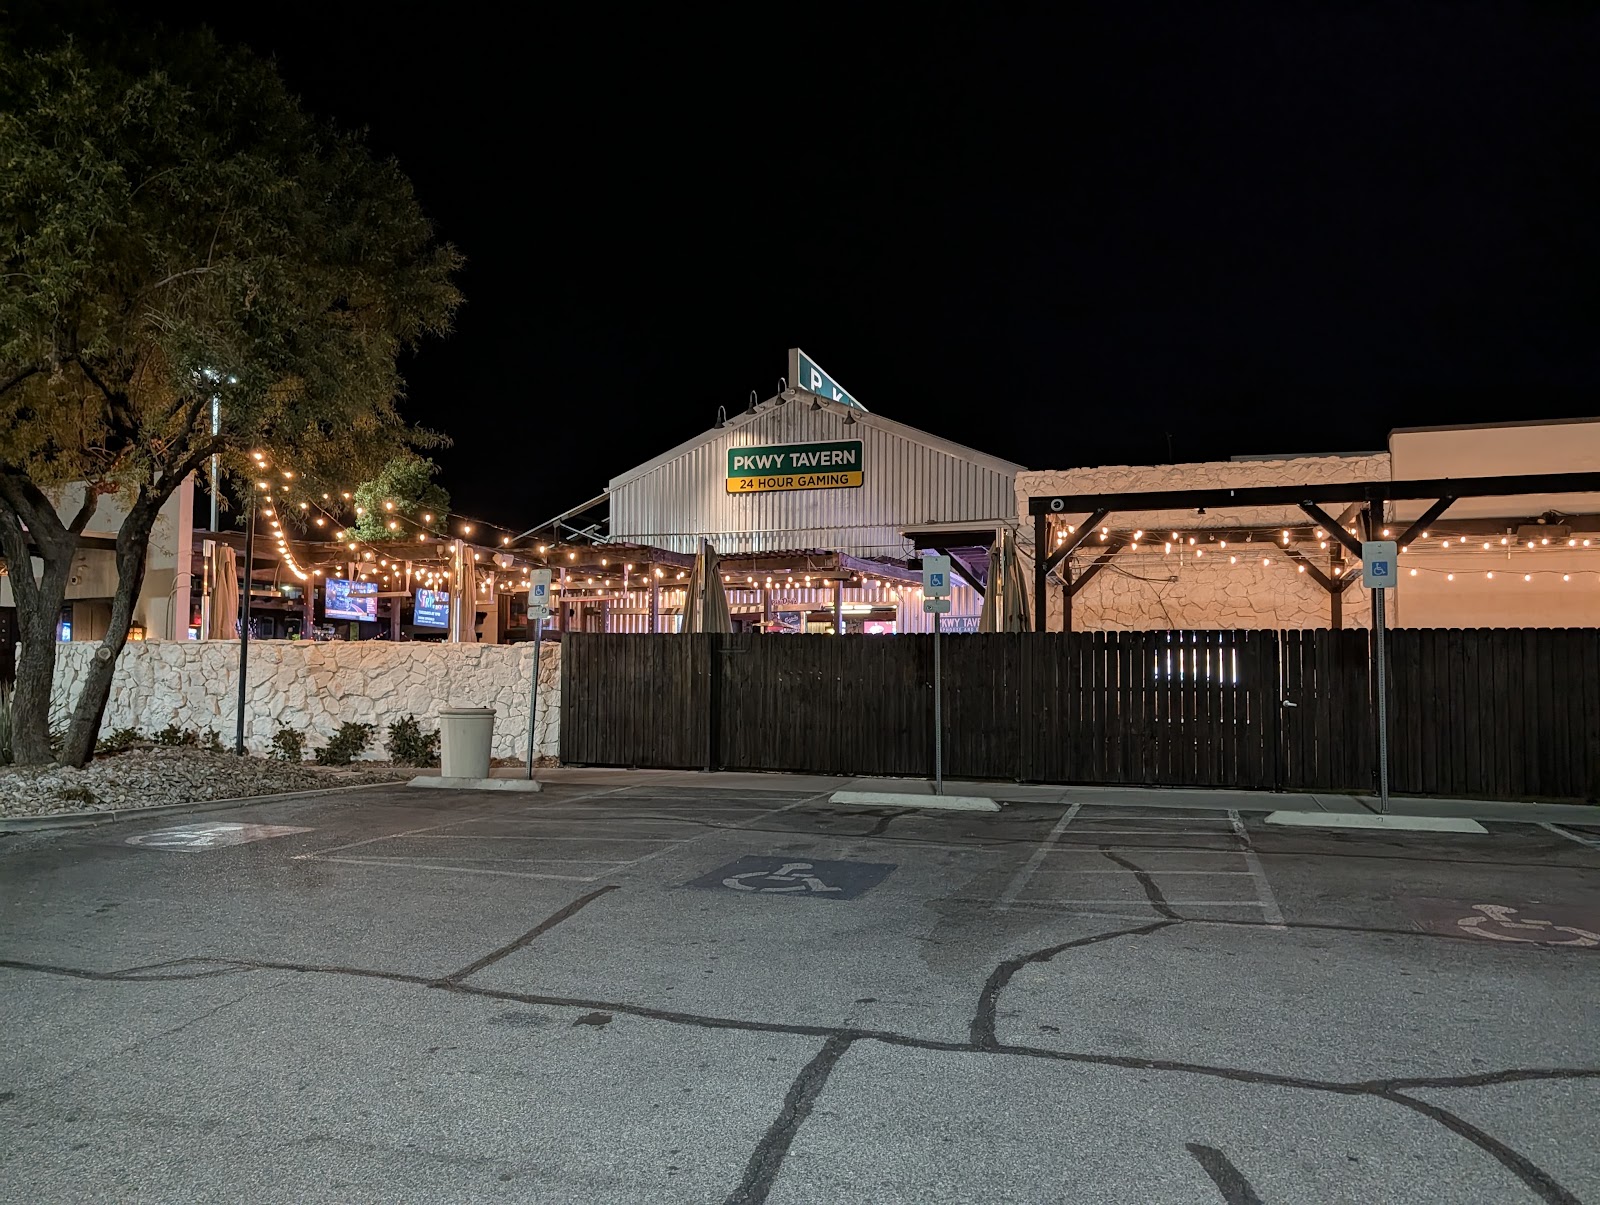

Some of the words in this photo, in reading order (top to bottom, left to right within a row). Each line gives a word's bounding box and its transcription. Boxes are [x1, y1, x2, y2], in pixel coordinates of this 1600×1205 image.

[733, 453, 785, 471] PKWY
[789, 449, 856, 468] TAVERN
[740, 479, 754, 489] 24
[758, 477, 793, 488] HOUR
[798, 474, 849, 487] GAMING
[940, 618, 960, 627] KWY
